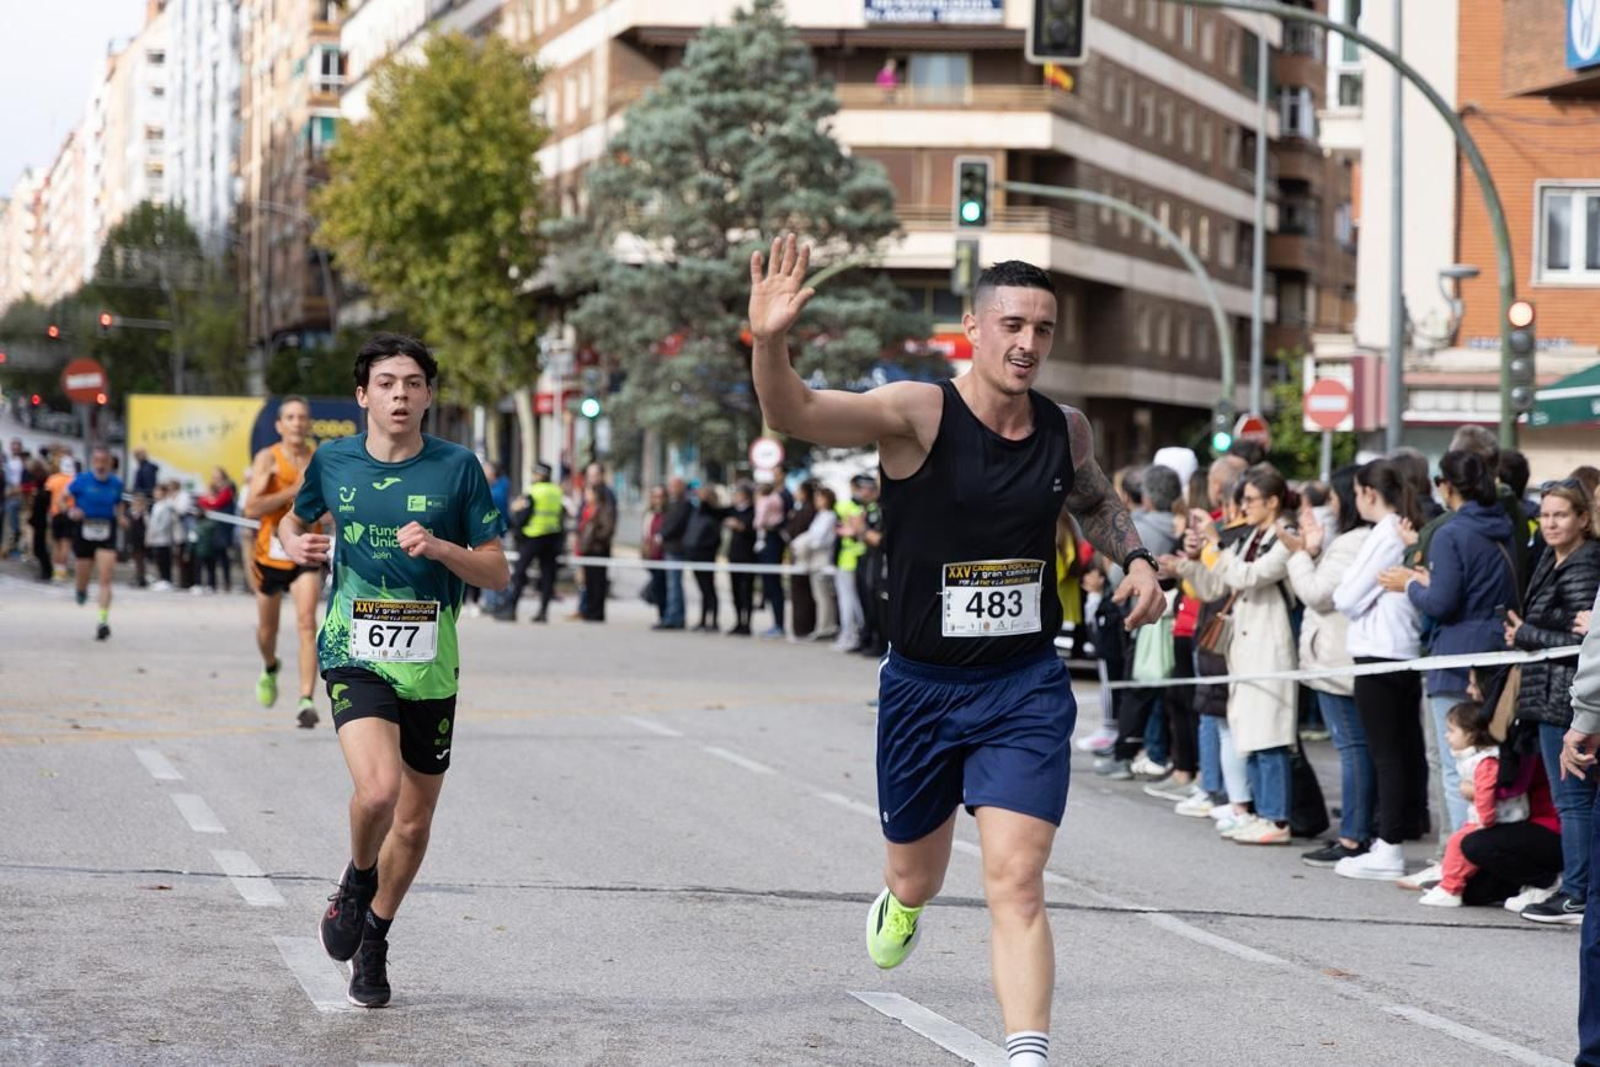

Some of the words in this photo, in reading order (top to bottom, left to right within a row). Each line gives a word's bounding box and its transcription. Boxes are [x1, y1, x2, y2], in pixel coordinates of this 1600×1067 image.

[948, 565, 971, 578] XXV
[972, 564, 1008, 572] CARRERA
[982, 571, 1003, 579] gran
[356, 602, 374, 613] XXV
[965, 589, 1023, 619] 483
[368, 624, 420, 648] 677
